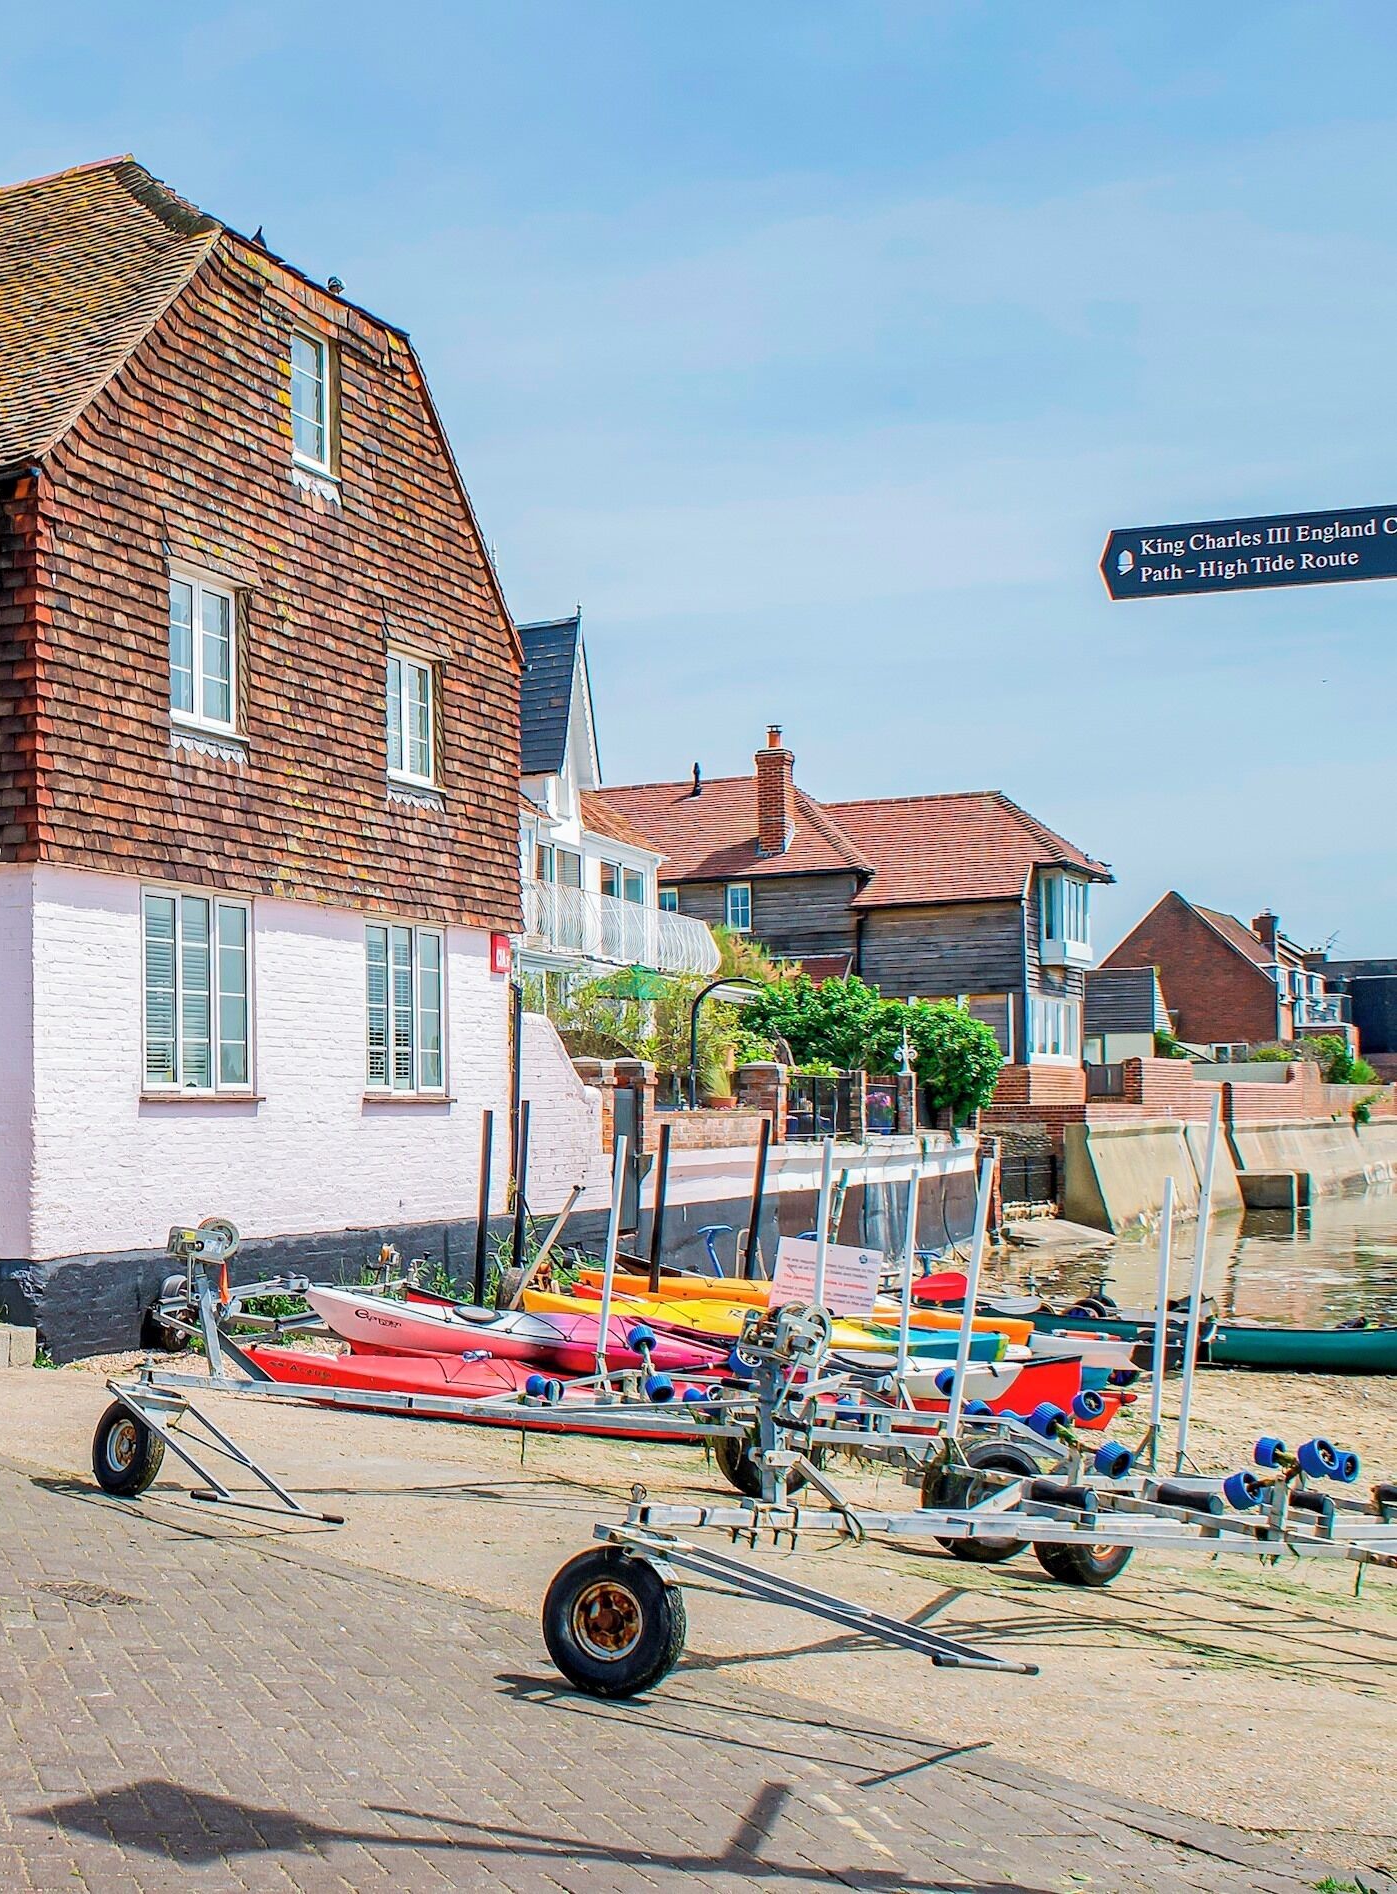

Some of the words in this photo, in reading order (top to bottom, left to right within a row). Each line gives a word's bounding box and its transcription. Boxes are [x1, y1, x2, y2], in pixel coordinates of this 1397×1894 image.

[1140, 538, 1185, 557] King
[1189, 530, 1262, 551] Charles
[1266, 527, 1291, 545] III
[1296, 519, 1377, 543] England
[1253, 554, 1295, 573] Tide
[1300, 550, 1360, 570] Route
